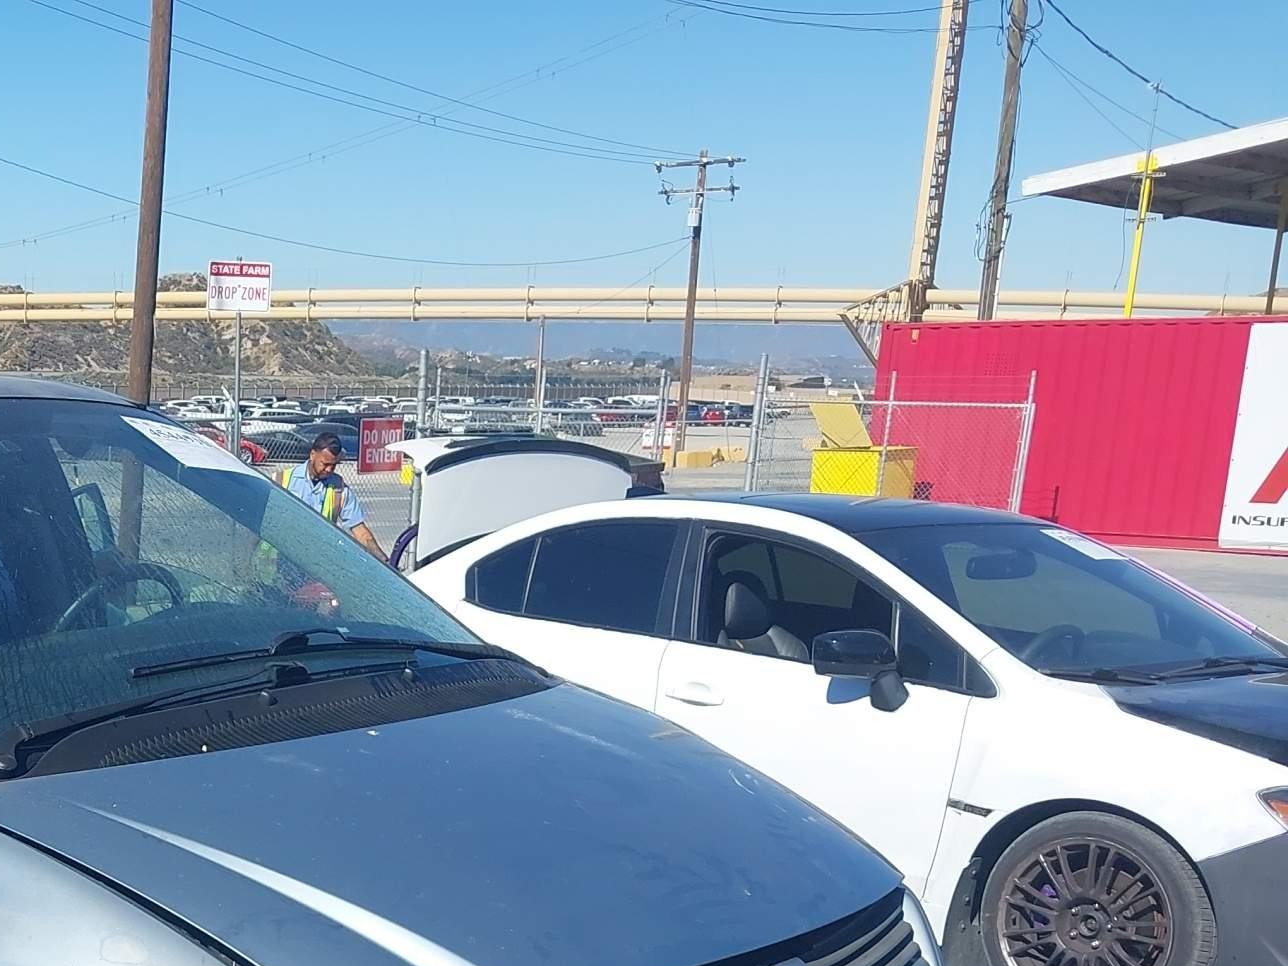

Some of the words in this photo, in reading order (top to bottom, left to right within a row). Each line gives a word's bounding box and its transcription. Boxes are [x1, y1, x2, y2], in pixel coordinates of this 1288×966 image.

[212, 265, 241, 275] STATE
[242, 266, 270, 276] FARM
[211, 285, 237, 300] DROP
[241, 287, 267, 301] ZONE
[363, 430, 378, 445] DO
[381, 429, 402, 444] NOT
[365, 448, 398, 464] ENTER
